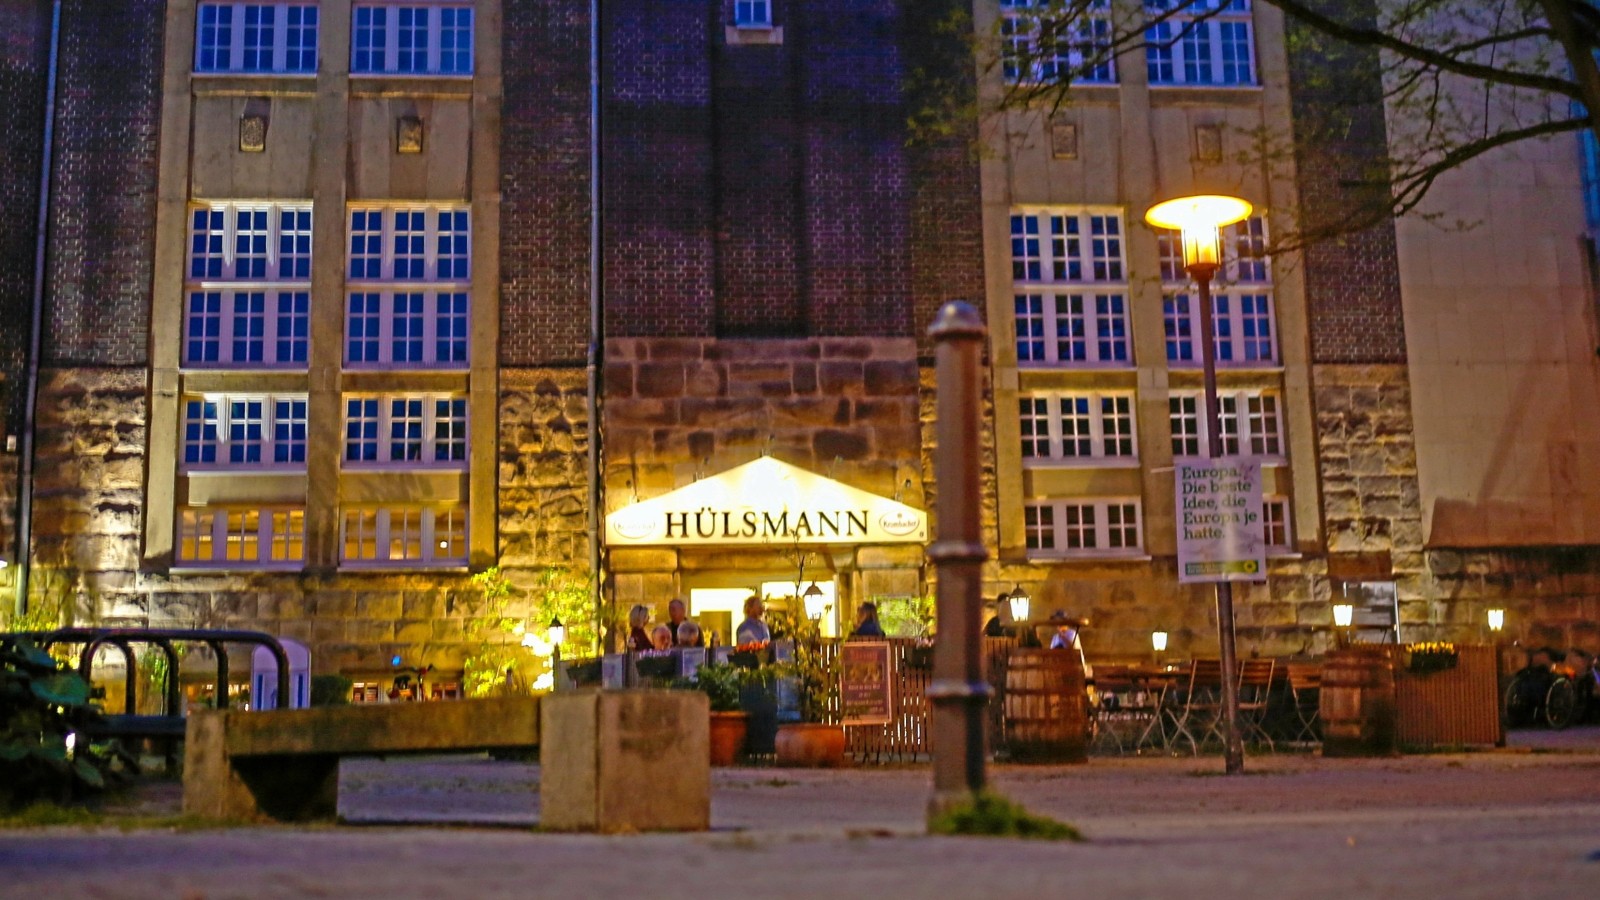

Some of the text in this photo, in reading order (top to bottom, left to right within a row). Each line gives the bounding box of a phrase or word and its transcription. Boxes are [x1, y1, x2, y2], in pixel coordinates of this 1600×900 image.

[1182, 466, 1242, 480] Europa.
[1182, 480, 1252, 494] Die beste
[1183, 494, 1247, 510] Idee, die
[664, 507, 868, 538] HÜLSMANN
[883, 520, 916, 528] Krombacher
[1183, 509, 1257, 526] Europa je
[1184, 526, 1225, 540] hatte.
